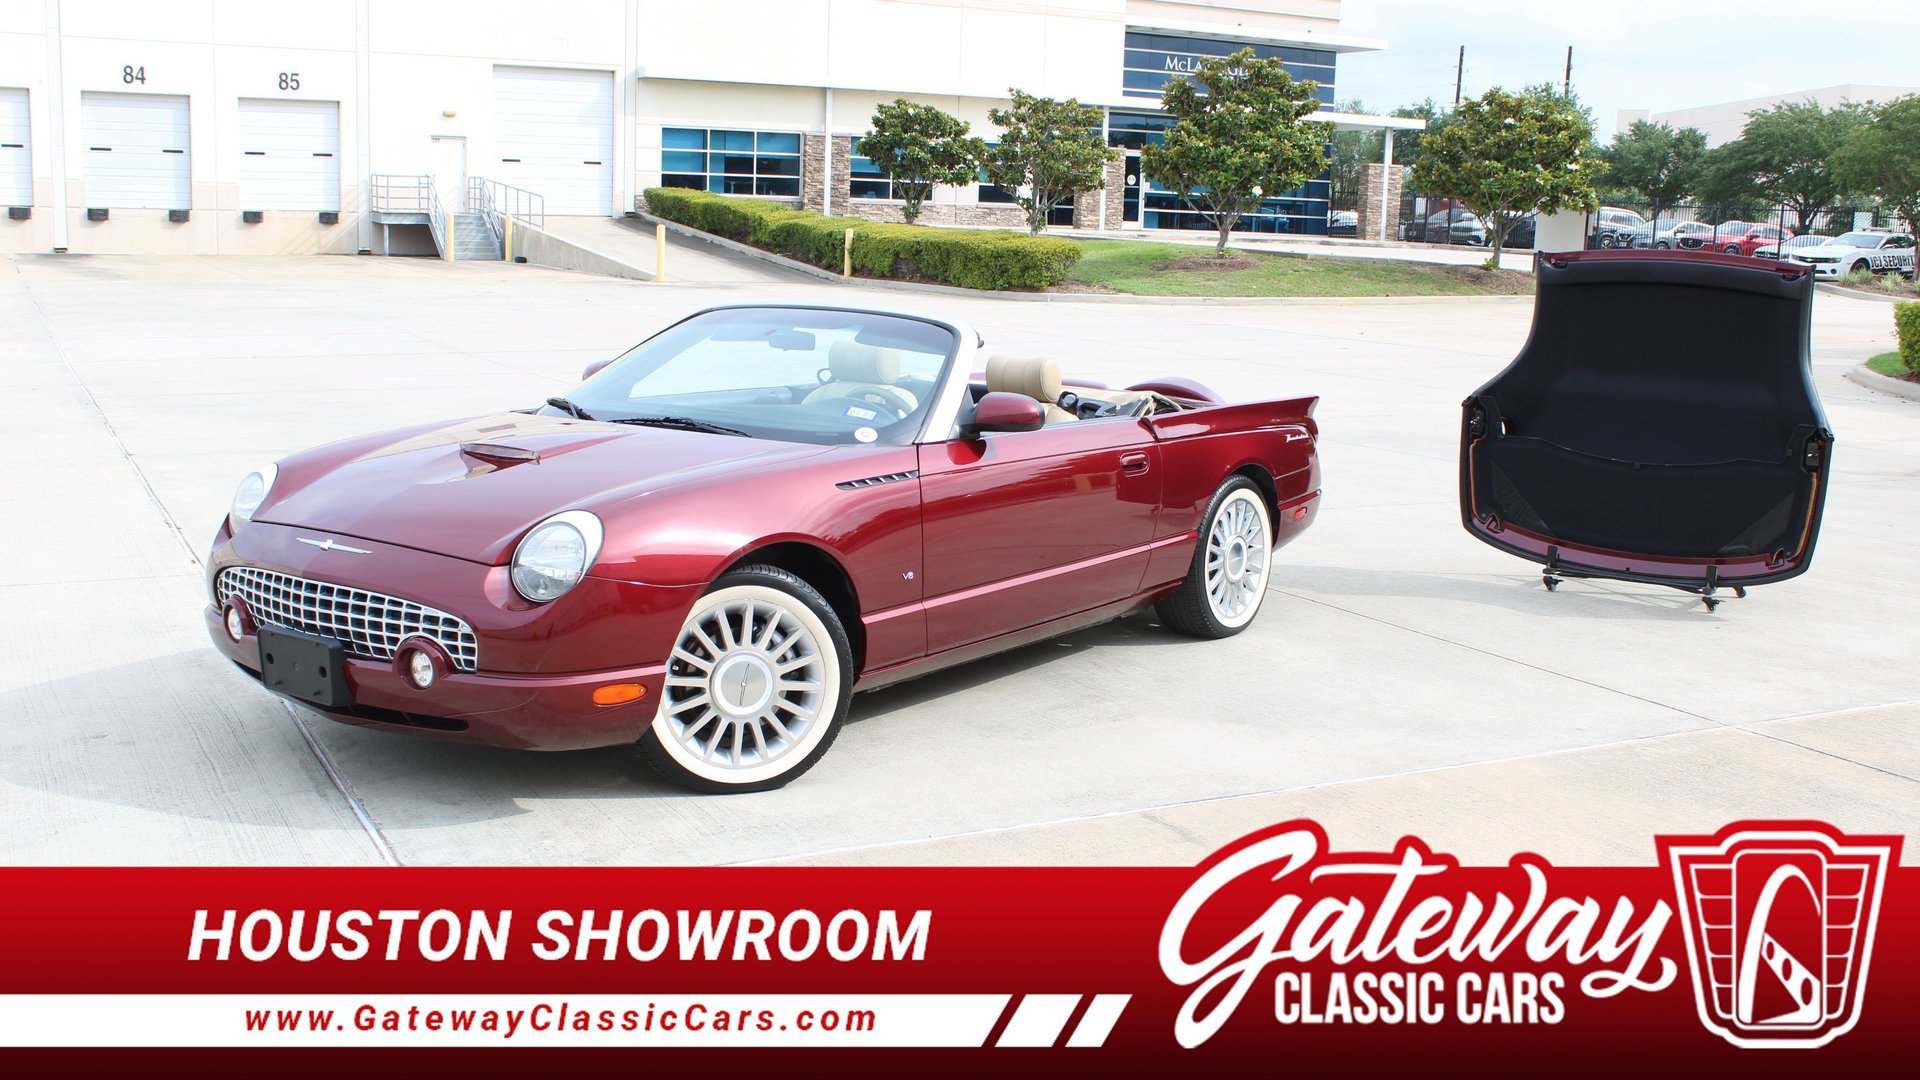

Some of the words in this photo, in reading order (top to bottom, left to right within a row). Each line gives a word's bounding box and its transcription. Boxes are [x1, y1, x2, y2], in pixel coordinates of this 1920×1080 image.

[122, 65, 147, 85] 84
[278, 72, 300, 91] 85
[1883, 255, 1916, 268] SECURIT
[902, 571, 914, 580] V8
